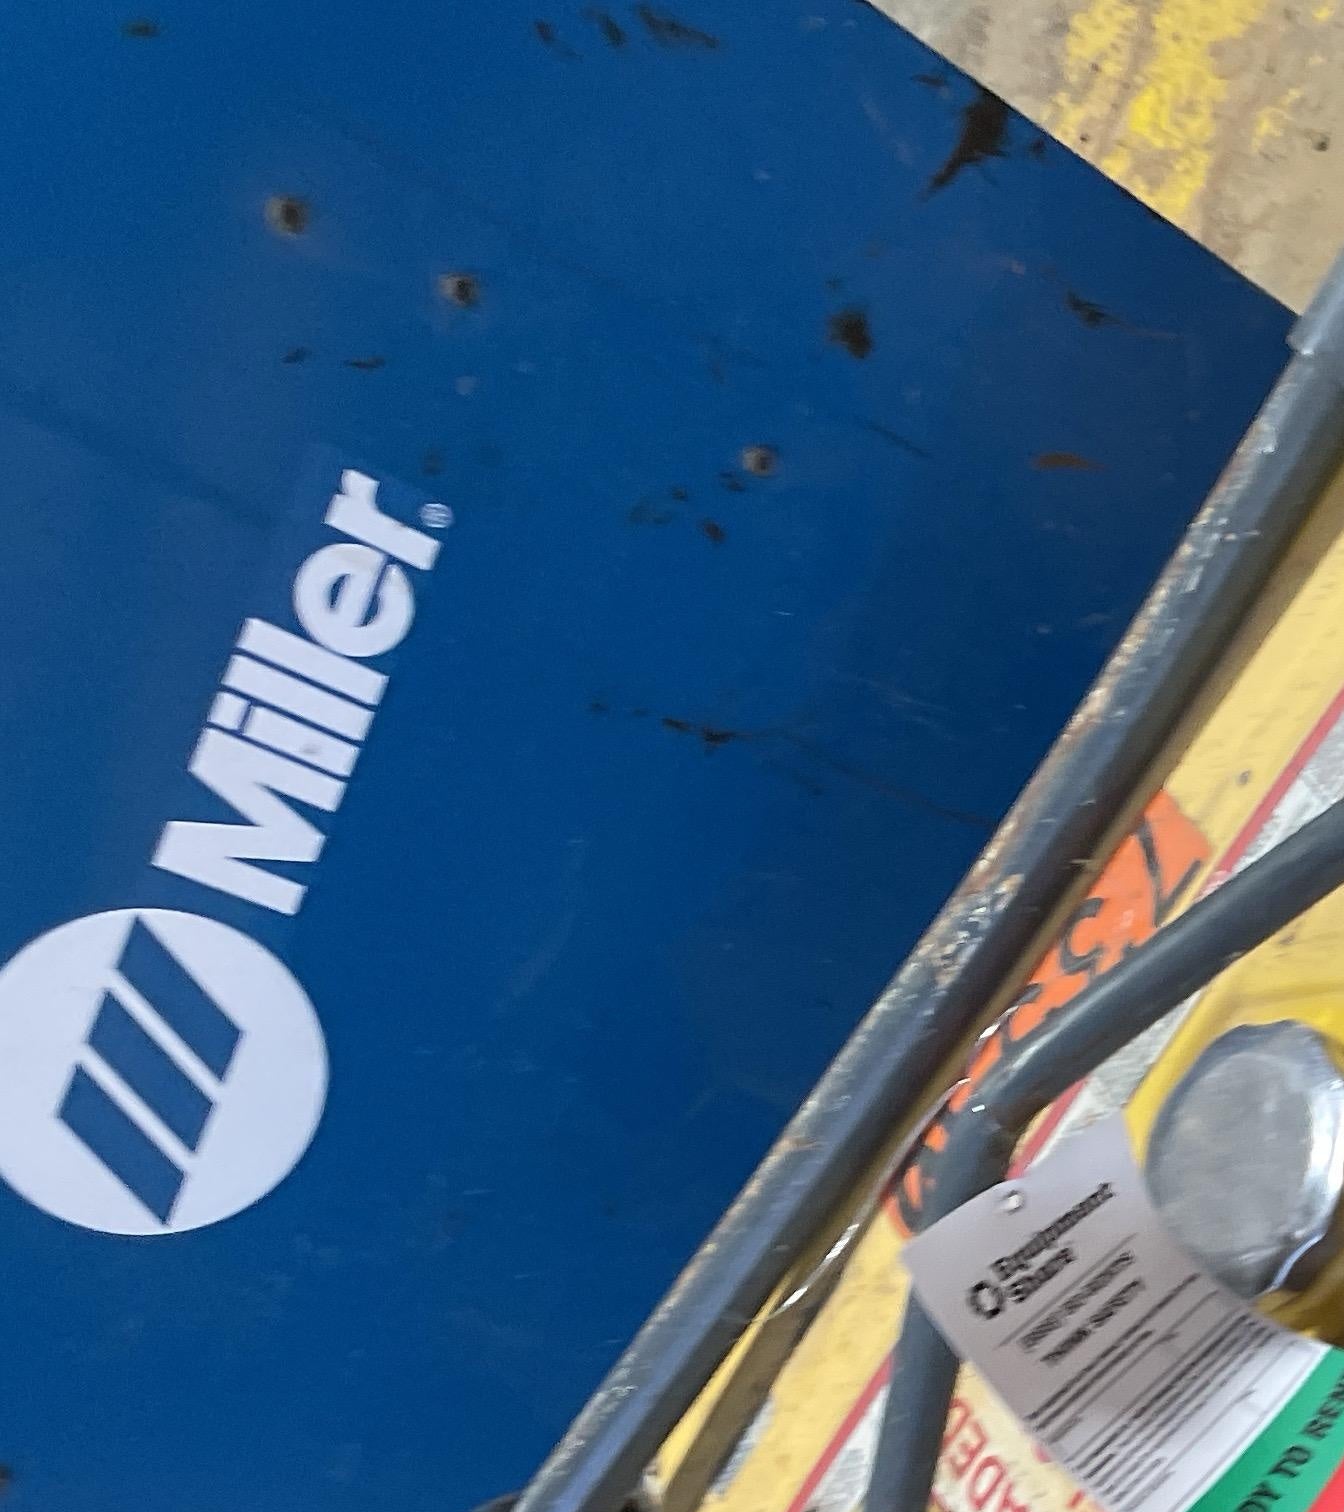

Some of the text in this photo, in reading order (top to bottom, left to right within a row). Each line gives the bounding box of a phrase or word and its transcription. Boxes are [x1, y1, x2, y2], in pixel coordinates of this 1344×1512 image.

[151, 468, 442, 916] Miller
[990, 1181, 1115, 1281] Equipment
[1004, 1247, 1077, 1303] Share
[1268, 1444, 1314, 1480] TO
